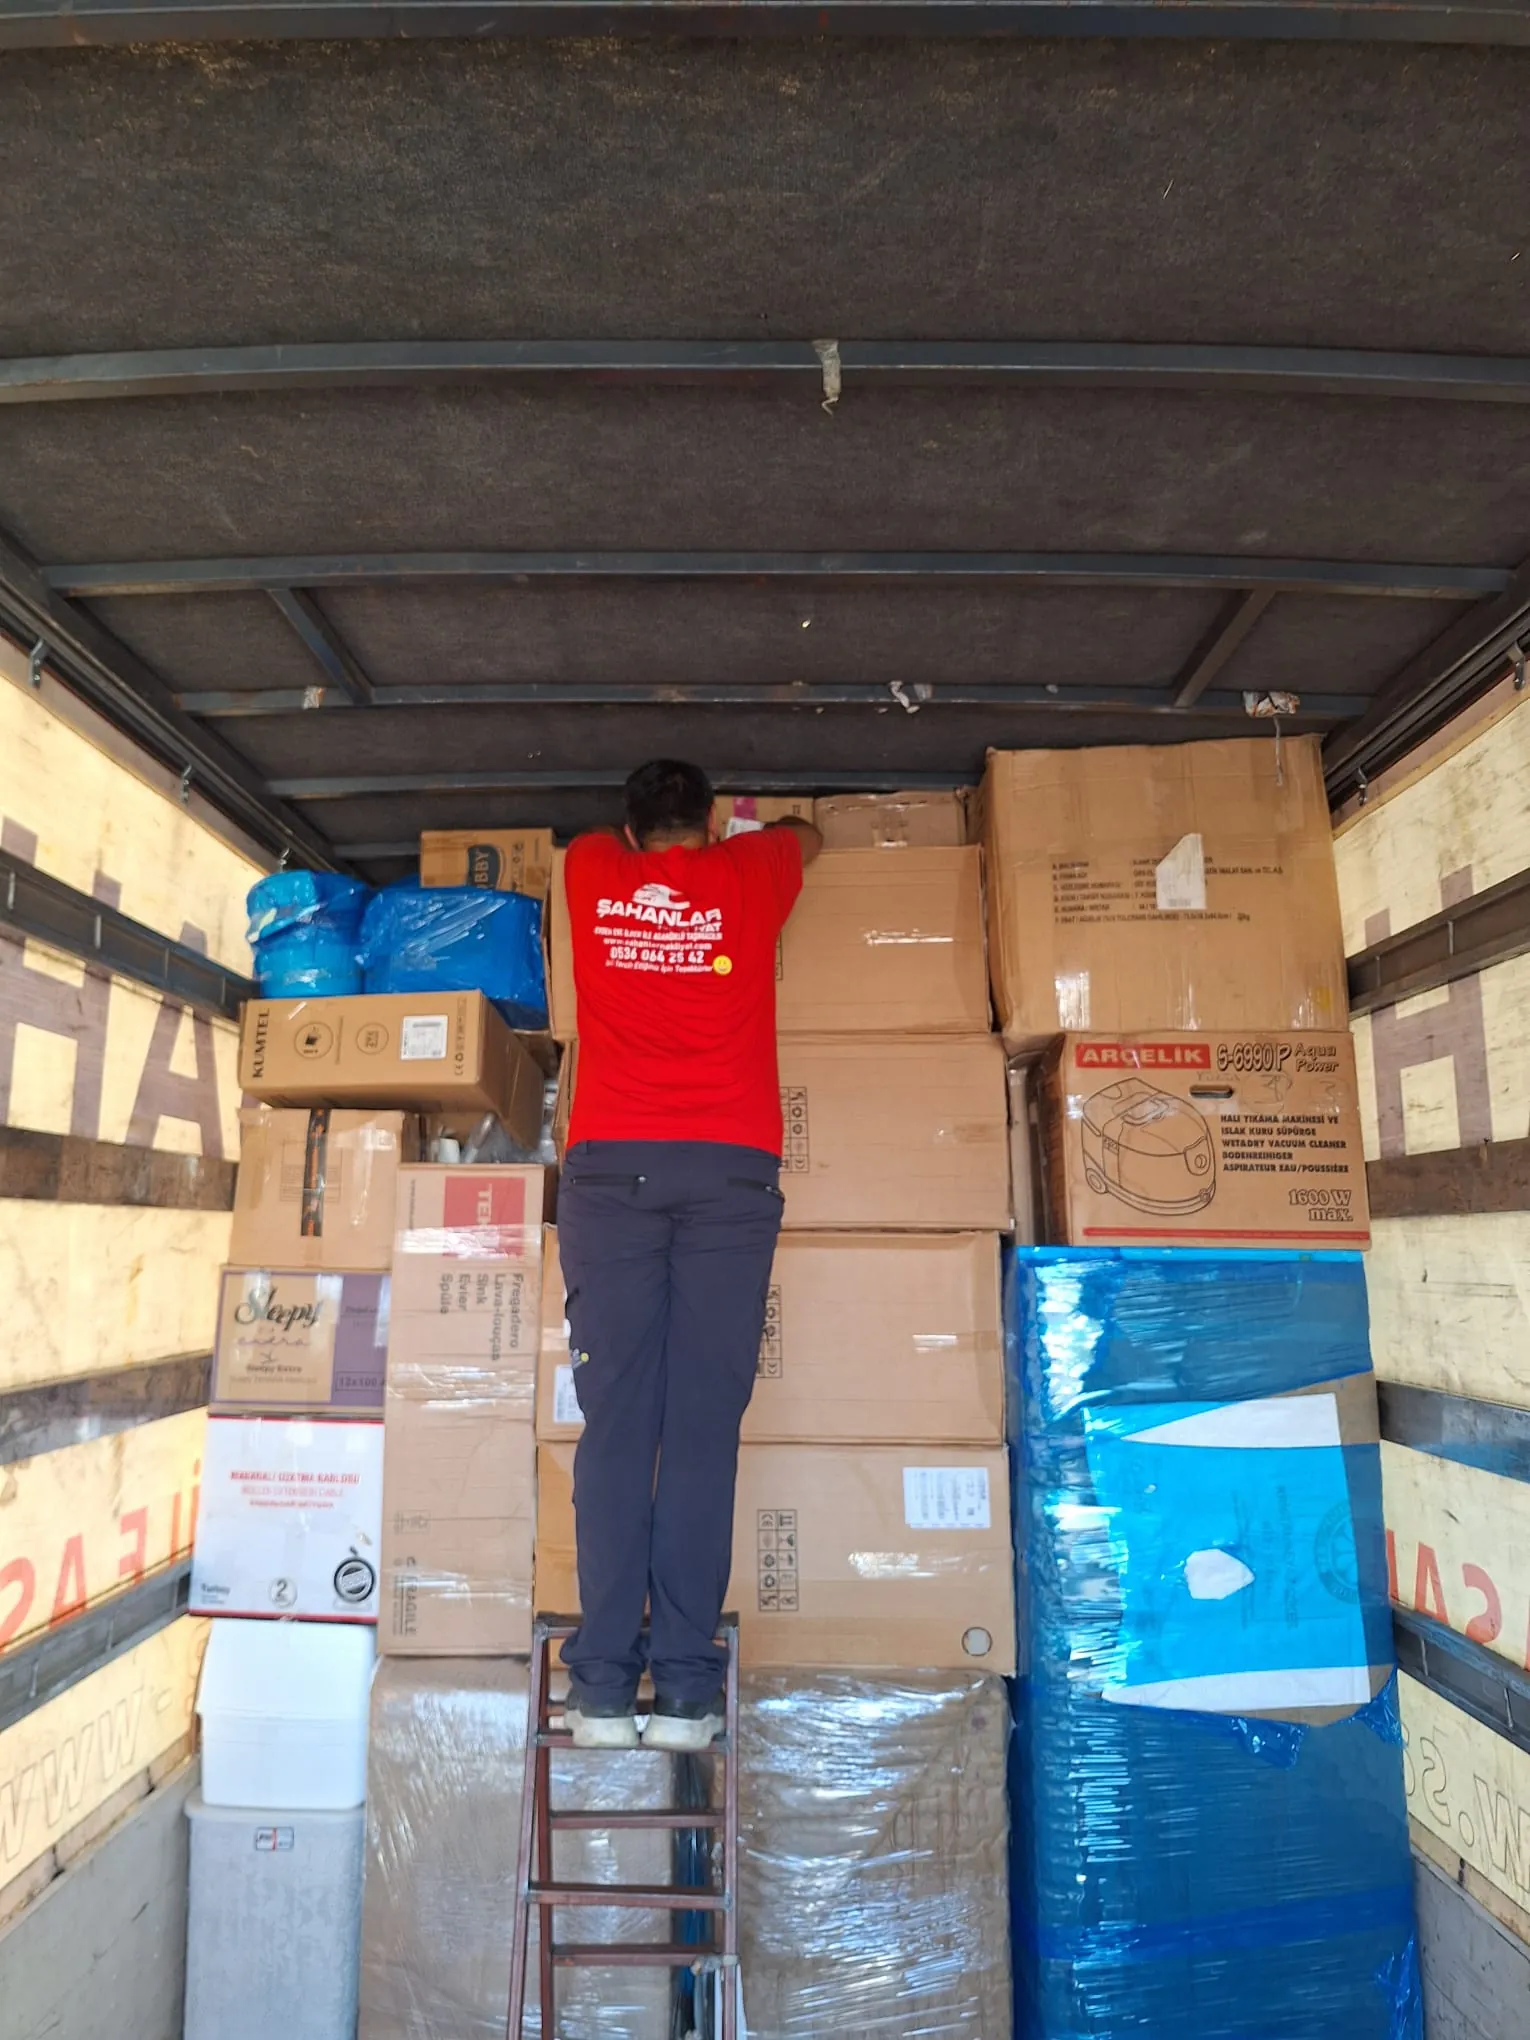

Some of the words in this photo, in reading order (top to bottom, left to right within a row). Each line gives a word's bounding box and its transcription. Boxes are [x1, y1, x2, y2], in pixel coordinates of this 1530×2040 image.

[610, 946, 637, 960] 0536
[252, 1009, 270, 1078] KUMTEL
[1082, 1046, 1204, 1067] ARÇELİK
[1294, 1043, 1337, 1063] Aqua
[1296, 1058, 1340, 1073] Power
[1220, 1114, 1241, 1124] HALI
[1243, 1115, 1279, 1124] YIKAMA
[1282, 1114, 1325, 1124] MAKİNESİ
[1327, 1116, 1339, 1125] VE
[1221, 1127, 1246, 1136] ISLAK
[1249, 1127, 1274, 1136] KURU
[1276, 1125, 1317, 1136] SÜPÜRGE
[1268, 1140, 1306, 1149] VACUUM
[1309, 1140, 1347, 1149] CLEANER
[1222, 1151, 1293, 1160] BODENREINIGER
[1223, 1163, 1276, 1173] ASPIRATEUR
[475, 1273, 490, 1305] Sink
[234, 1285, 324, 1332] Sleepy
[508, 1273, 525, 1349] Fregadero
[491, 1273, 507, 1361] Lava-louças
